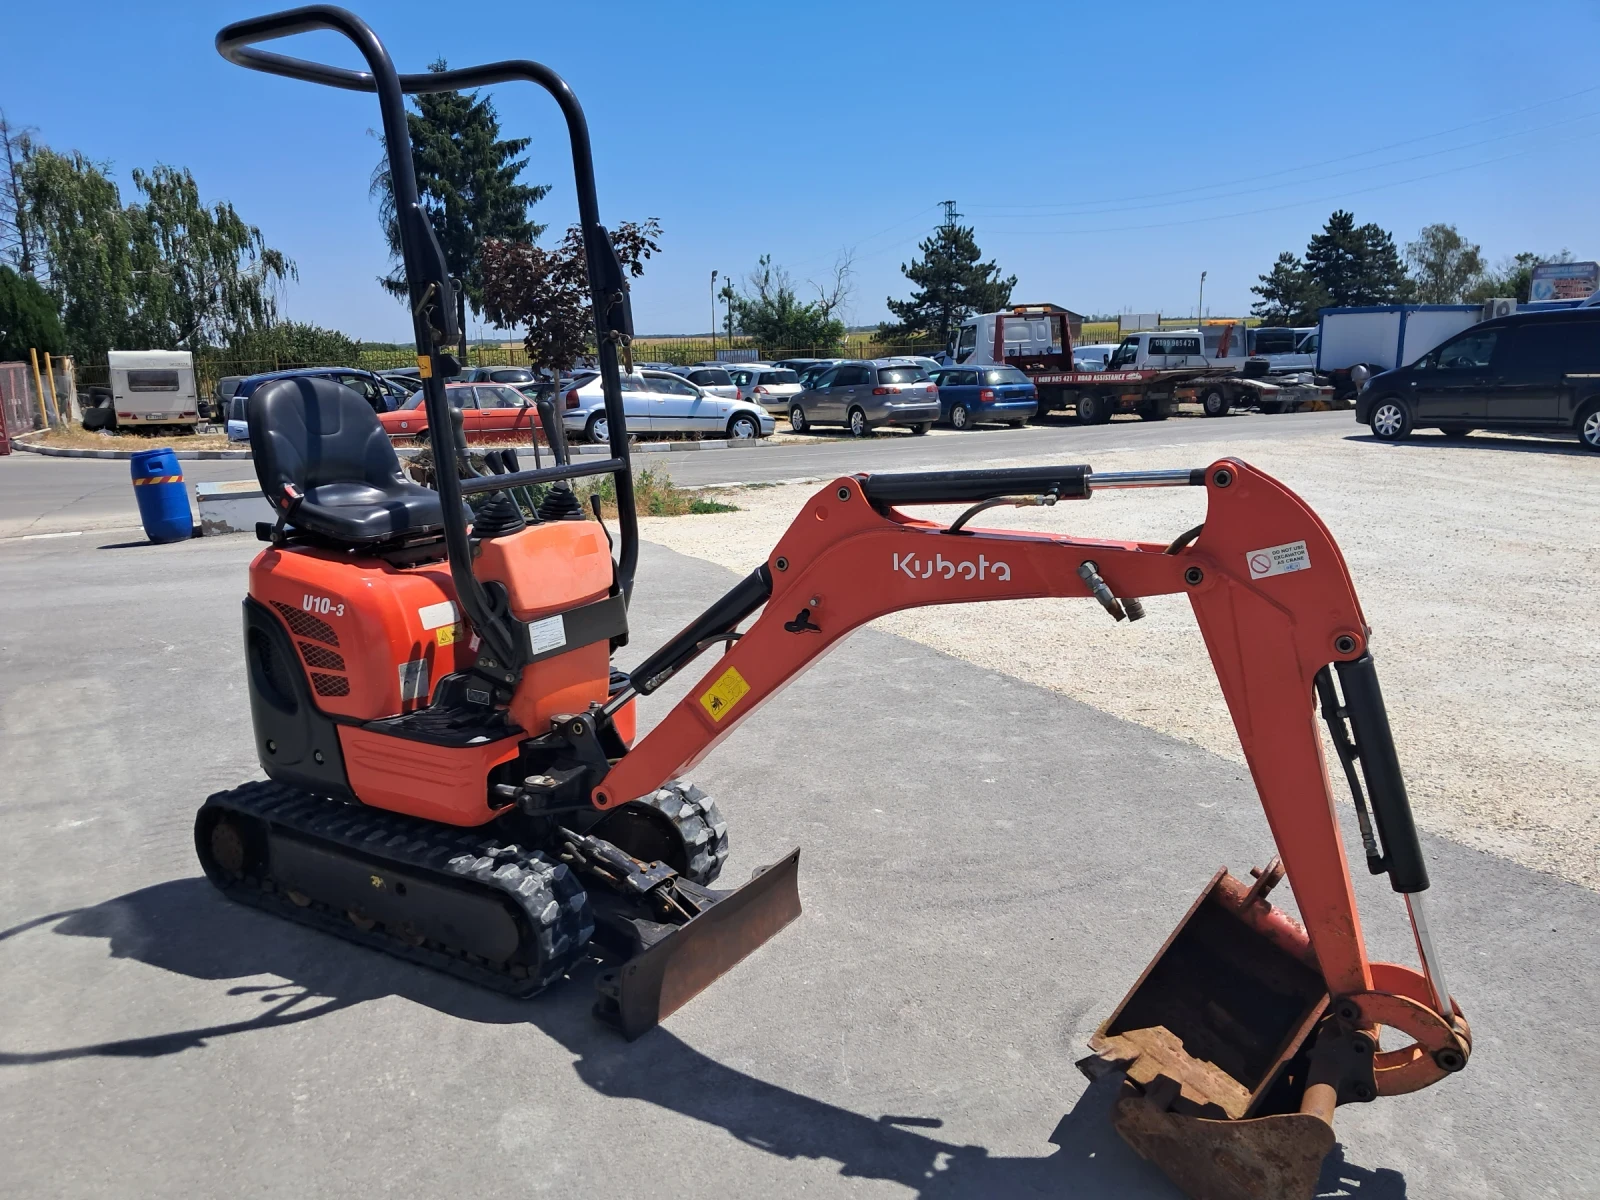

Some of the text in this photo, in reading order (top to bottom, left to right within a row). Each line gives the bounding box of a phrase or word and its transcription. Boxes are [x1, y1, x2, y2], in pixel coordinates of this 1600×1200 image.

[1093, 373, 1125, 381] ASSISTANCE
[1274, 550, 1305, 560] EXCAVATOR
[893, 552, 1011, 582] Kubota
[303, 594, 345, 617] U10-3
